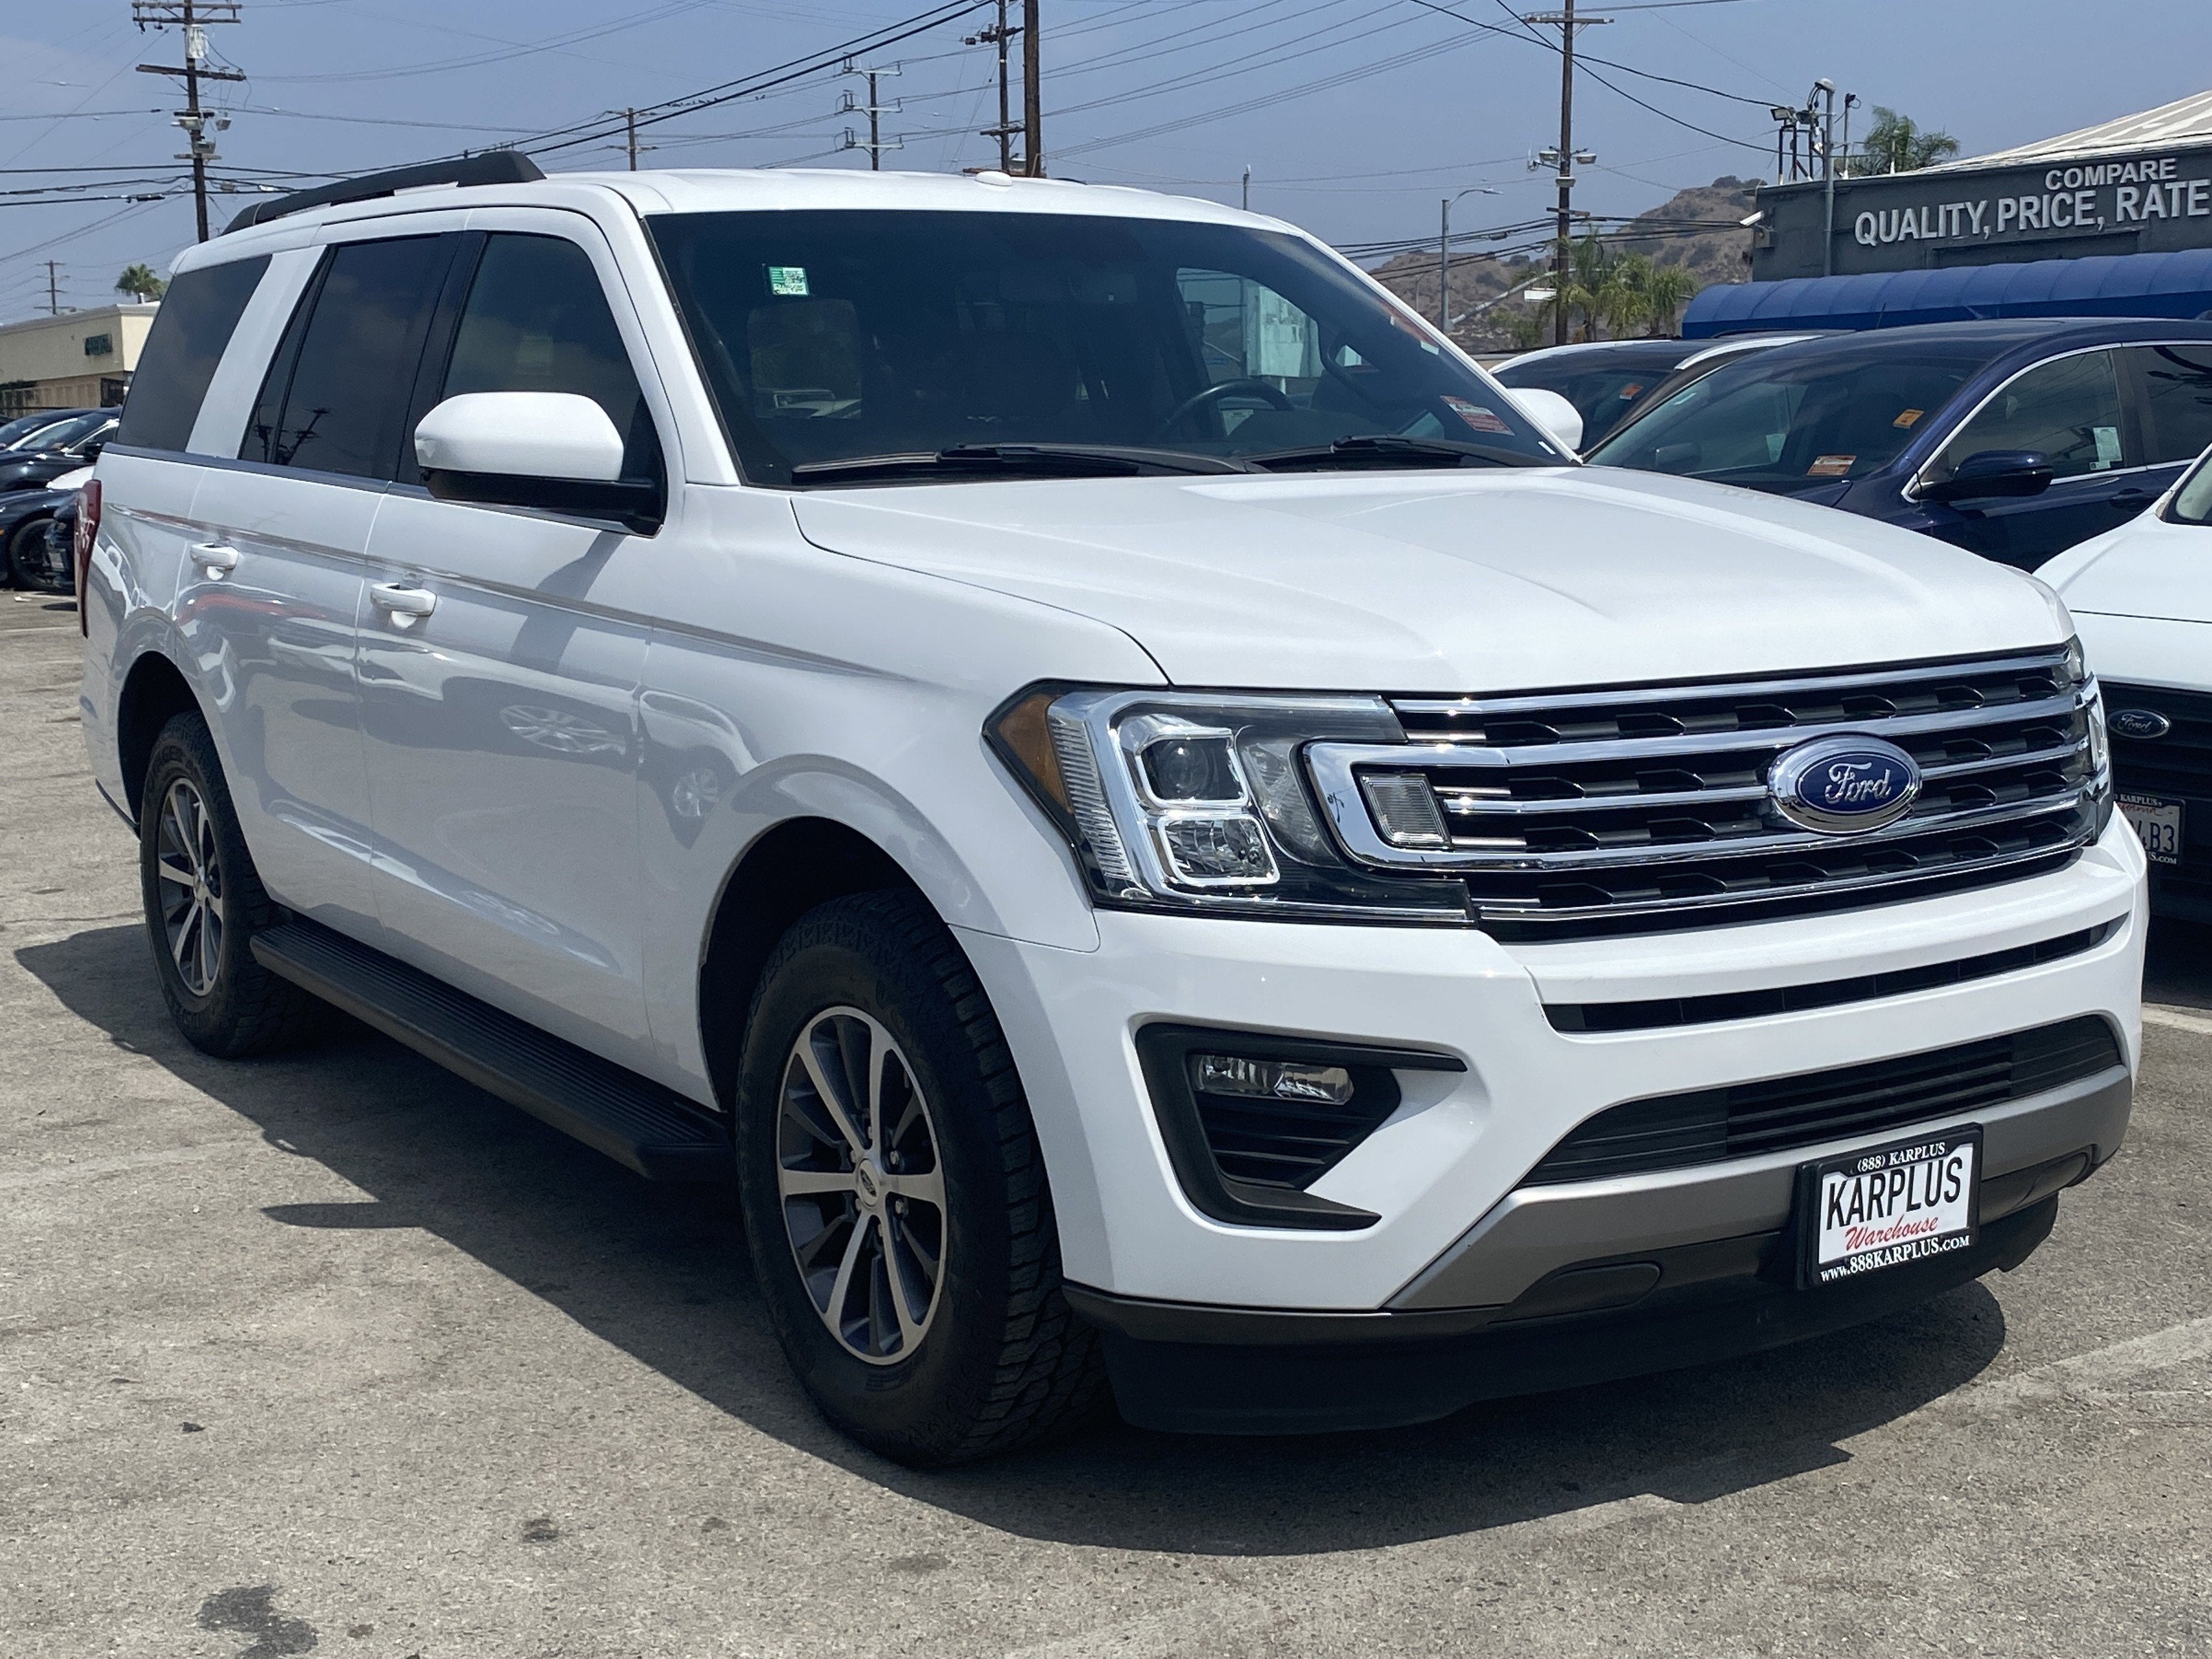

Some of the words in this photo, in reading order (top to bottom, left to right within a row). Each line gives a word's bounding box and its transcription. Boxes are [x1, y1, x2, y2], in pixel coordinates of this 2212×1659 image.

[2045, 158, 2178, 190] COMPARE
[1854, 199, 1991, 247] QUALITY,
[1997, 190, 2106, 232] PRICE,
[2116, 178, 2211, 223] RATE
[2118, 713, 2152, 733] Ford
[1825, 762, 1892, 805] Ford
[1857, 1155, 1886, 1173] (888)
[1889, 1141, 1945, 1166] KARPLUS
[1826, 1156, 1963, 1231] KARPLUS
[1844, 1213, 1939, 1252] Warehouse
